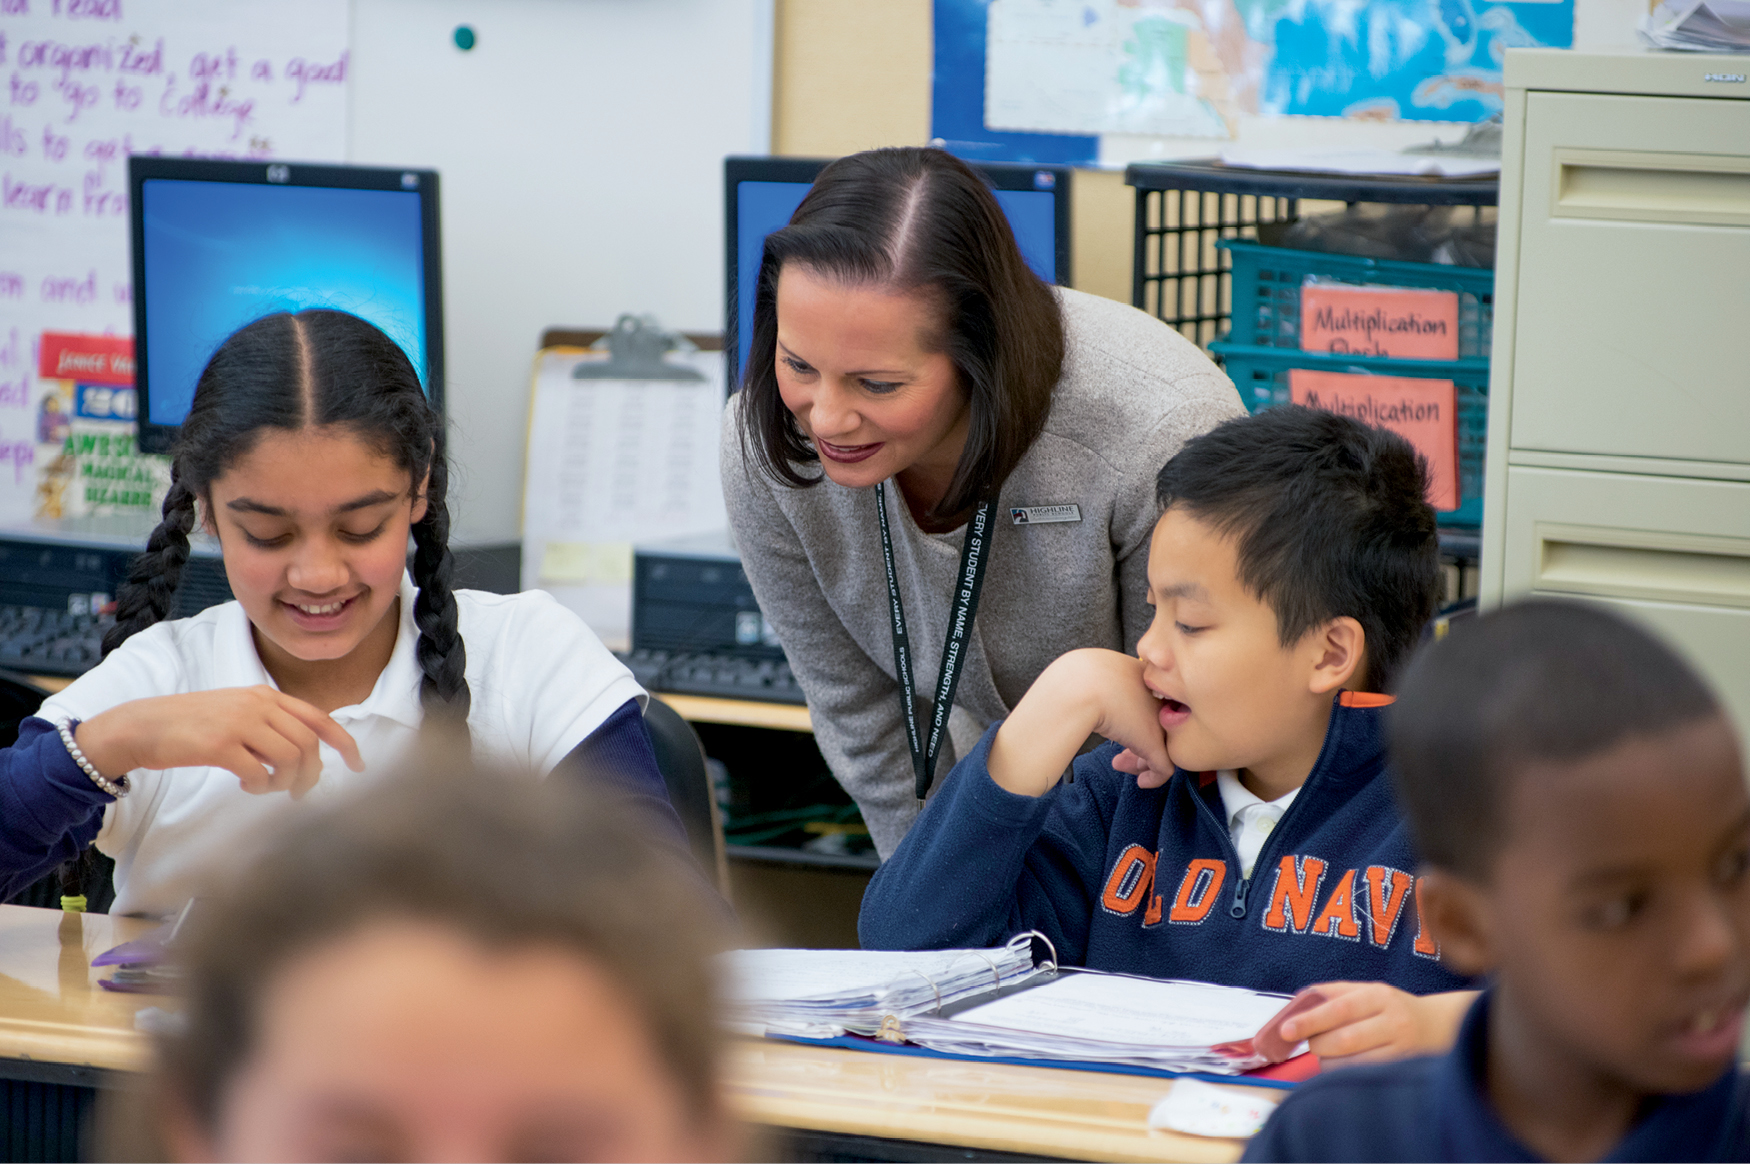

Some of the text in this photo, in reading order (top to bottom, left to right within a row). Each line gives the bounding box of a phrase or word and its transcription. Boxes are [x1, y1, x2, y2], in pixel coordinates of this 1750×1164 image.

[252, 59, 272, 82] a
[10, 71, 39, 106] to
[114, 79, 143, 111] to
[43, 122, 69, 162] to
[84, 170, 131, 216] fro
[1313, 305, 1448, 342] Multiplication
[1030, 505, 1074, 514] HIGHLINE
[882, 529, 889, 545] BY
[885, 545, 897, 596] STUDENT
[892, 598, 903, 635] EVERY
[928, 501, 988, 758] EVERY STUDENT BY NAME, STRENGTH, AND NEED
[899, 646, 920, 753] HIGHLINE PUBLIC SCHOOLS
